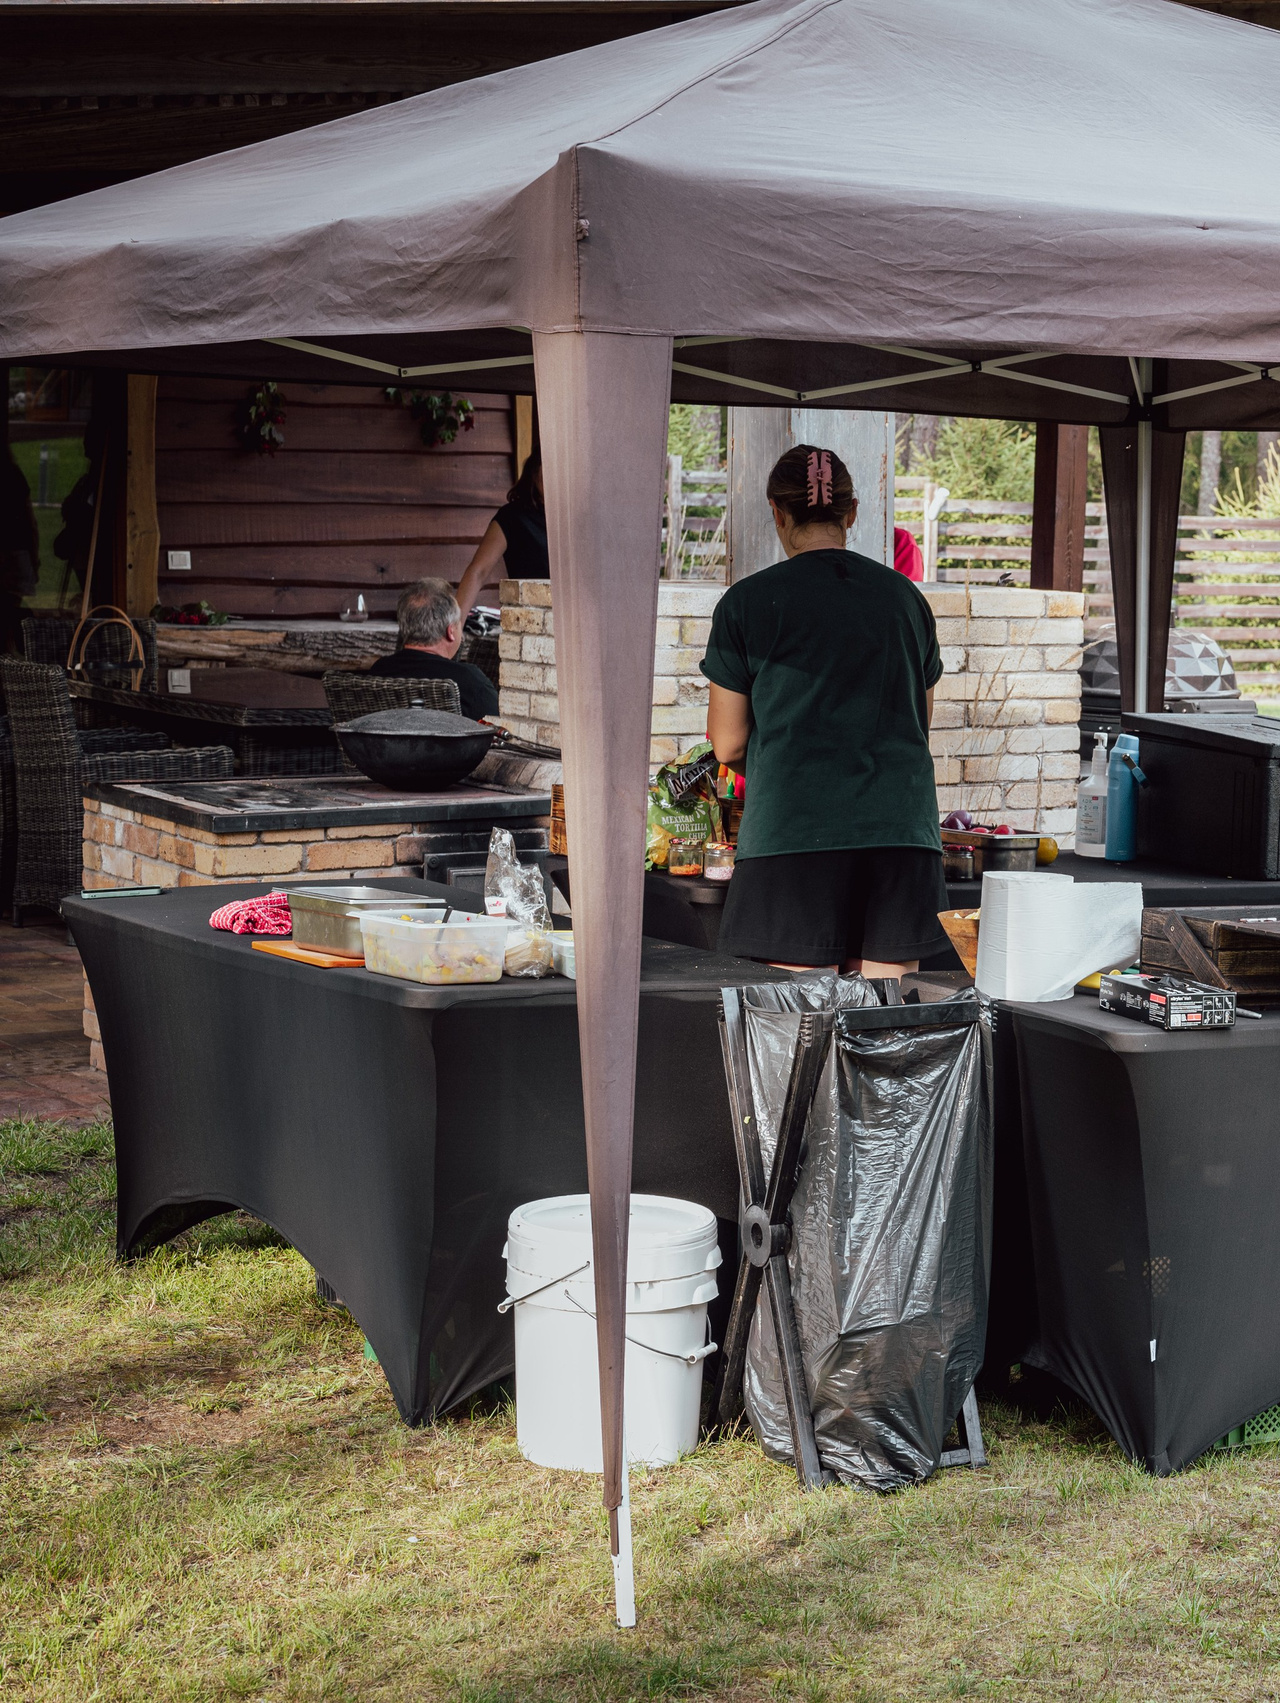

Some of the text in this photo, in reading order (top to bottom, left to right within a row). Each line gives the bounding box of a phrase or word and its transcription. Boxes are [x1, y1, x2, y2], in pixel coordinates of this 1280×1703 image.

[661, 815, 695, 824] MEXICAN
[675, 823, 708, 833] TORTILLA
[688, 832, 706, 840] CHIPS
